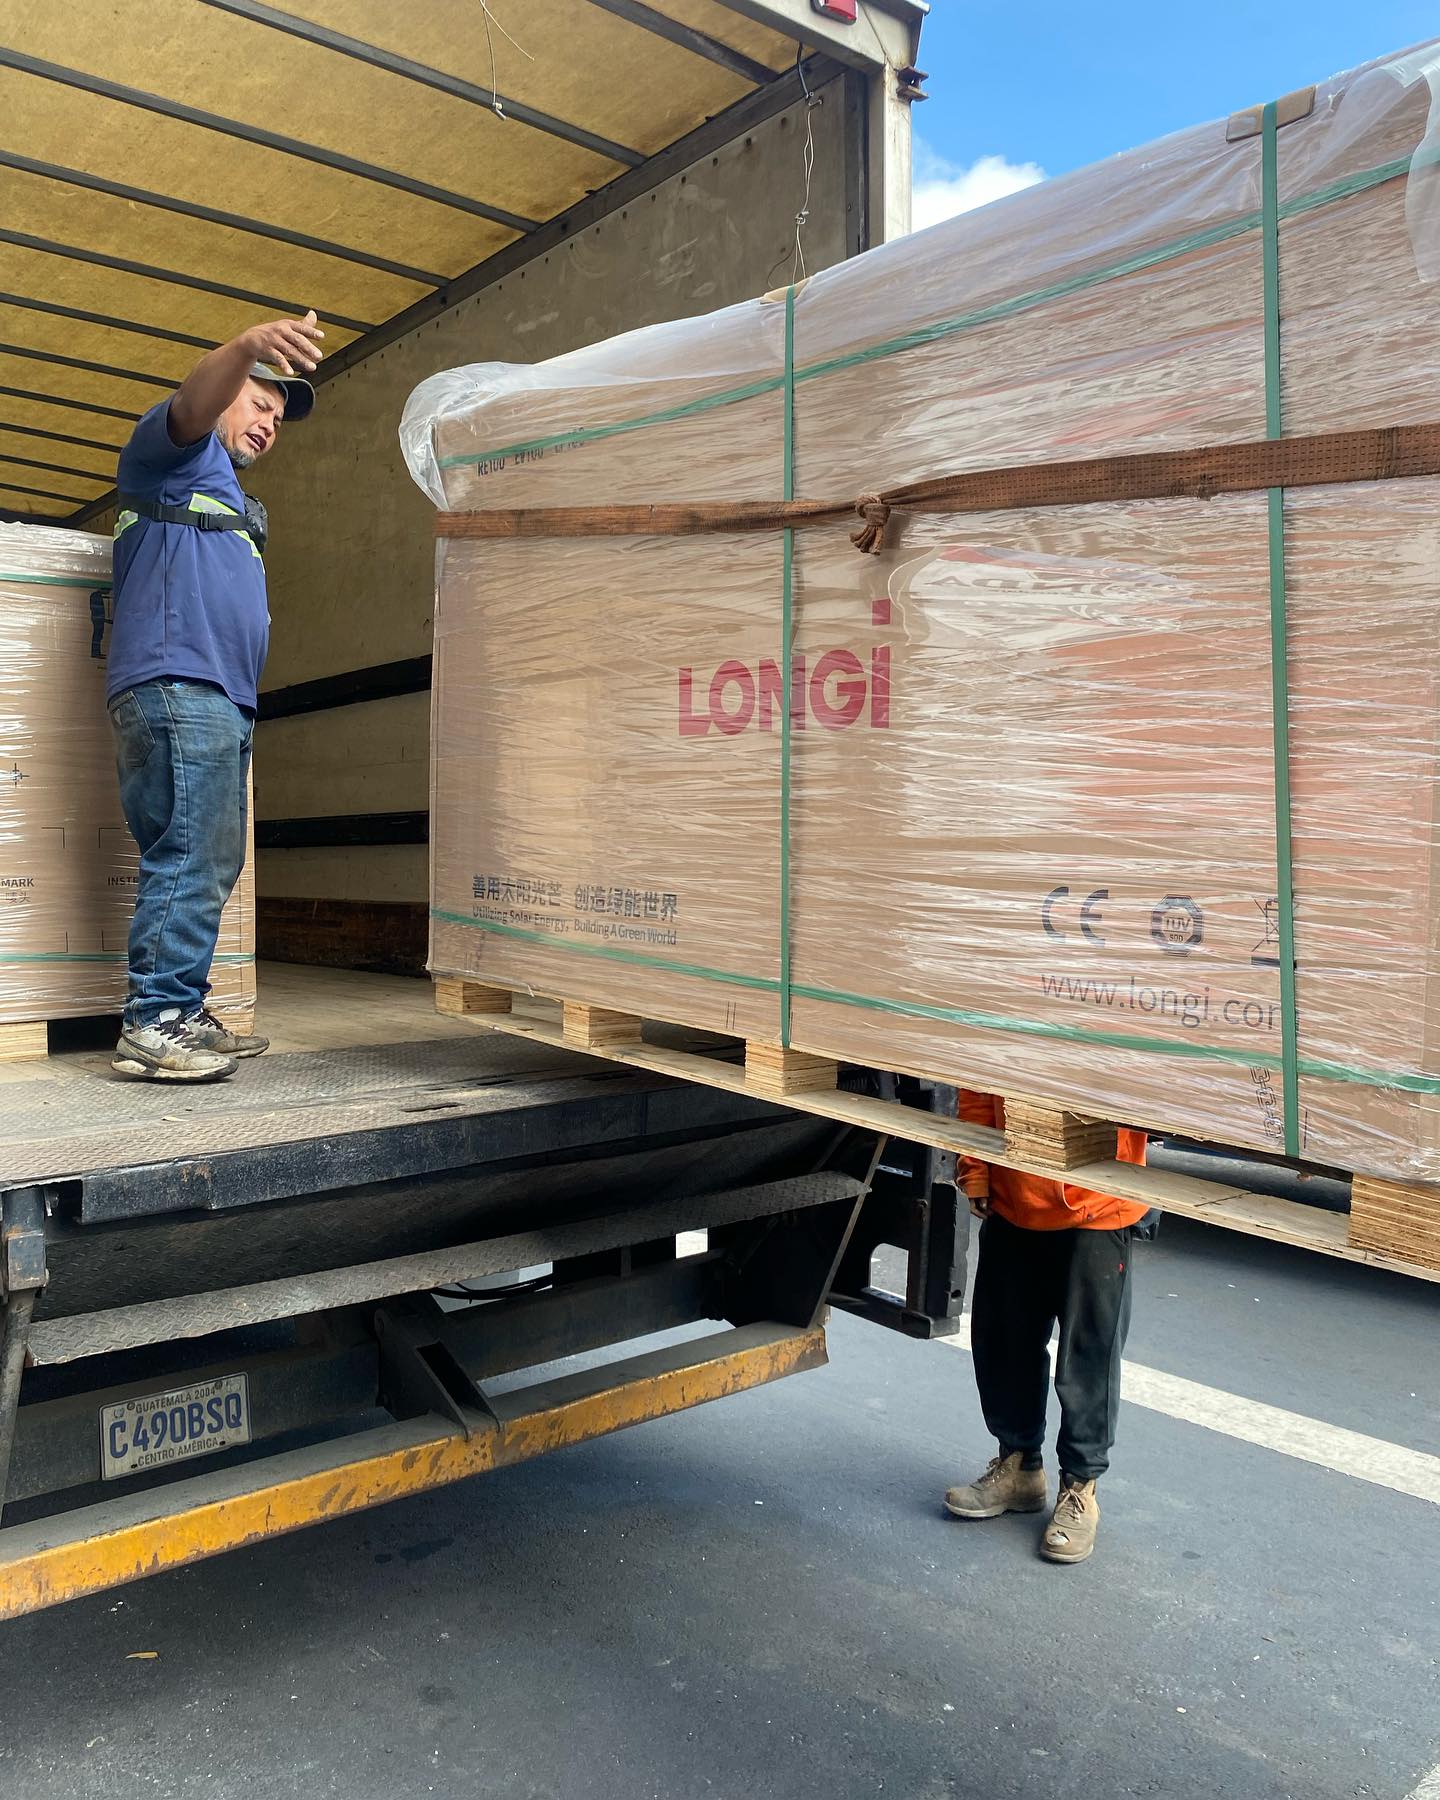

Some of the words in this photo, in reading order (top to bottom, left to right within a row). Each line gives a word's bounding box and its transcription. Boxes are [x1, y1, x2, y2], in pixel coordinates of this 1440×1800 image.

[1, 877, 35, 888] MARK
[575, 884, 678, 922] 创造绿能世界
[472, 903, 508, 925] Utilizing
[509, 909, 531, 923] Solar
[574, 918, 610, 940] Building
[609, 923, 617, 937] A
[618, 924, 646, 941] Green
[647, 927, 677, 946] World
[135, 1392, 192, 1414] GUATEMALA
[194, 1386, 216, 1401] 2004
[137, 1449, 175, 1467] CENTRO
[177, 1438, 219, 1456] AMÉRICA
